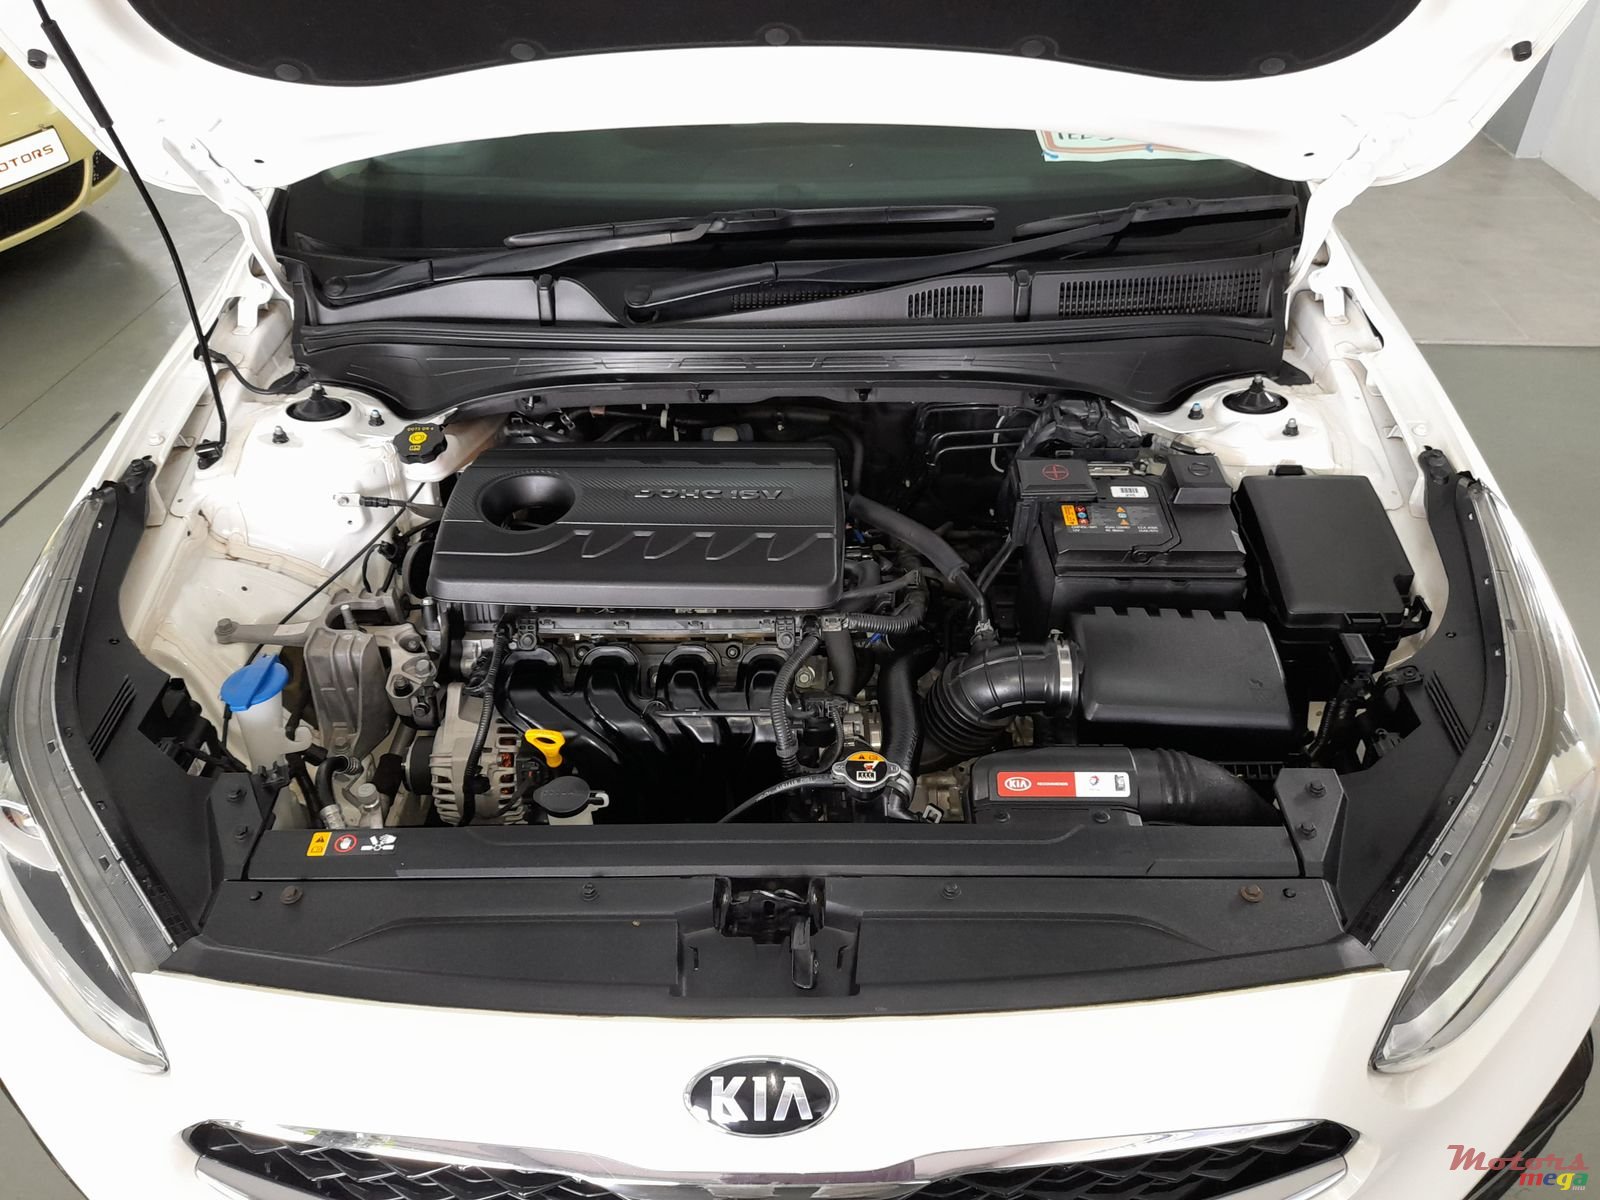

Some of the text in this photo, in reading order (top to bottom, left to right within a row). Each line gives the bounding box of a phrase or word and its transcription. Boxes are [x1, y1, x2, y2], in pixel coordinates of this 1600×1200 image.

[634, 488, 782, 500] DOHC 16V
[1008, 777, 1027, 789] KIA
[710, 1076, 813, 1121] KIA
